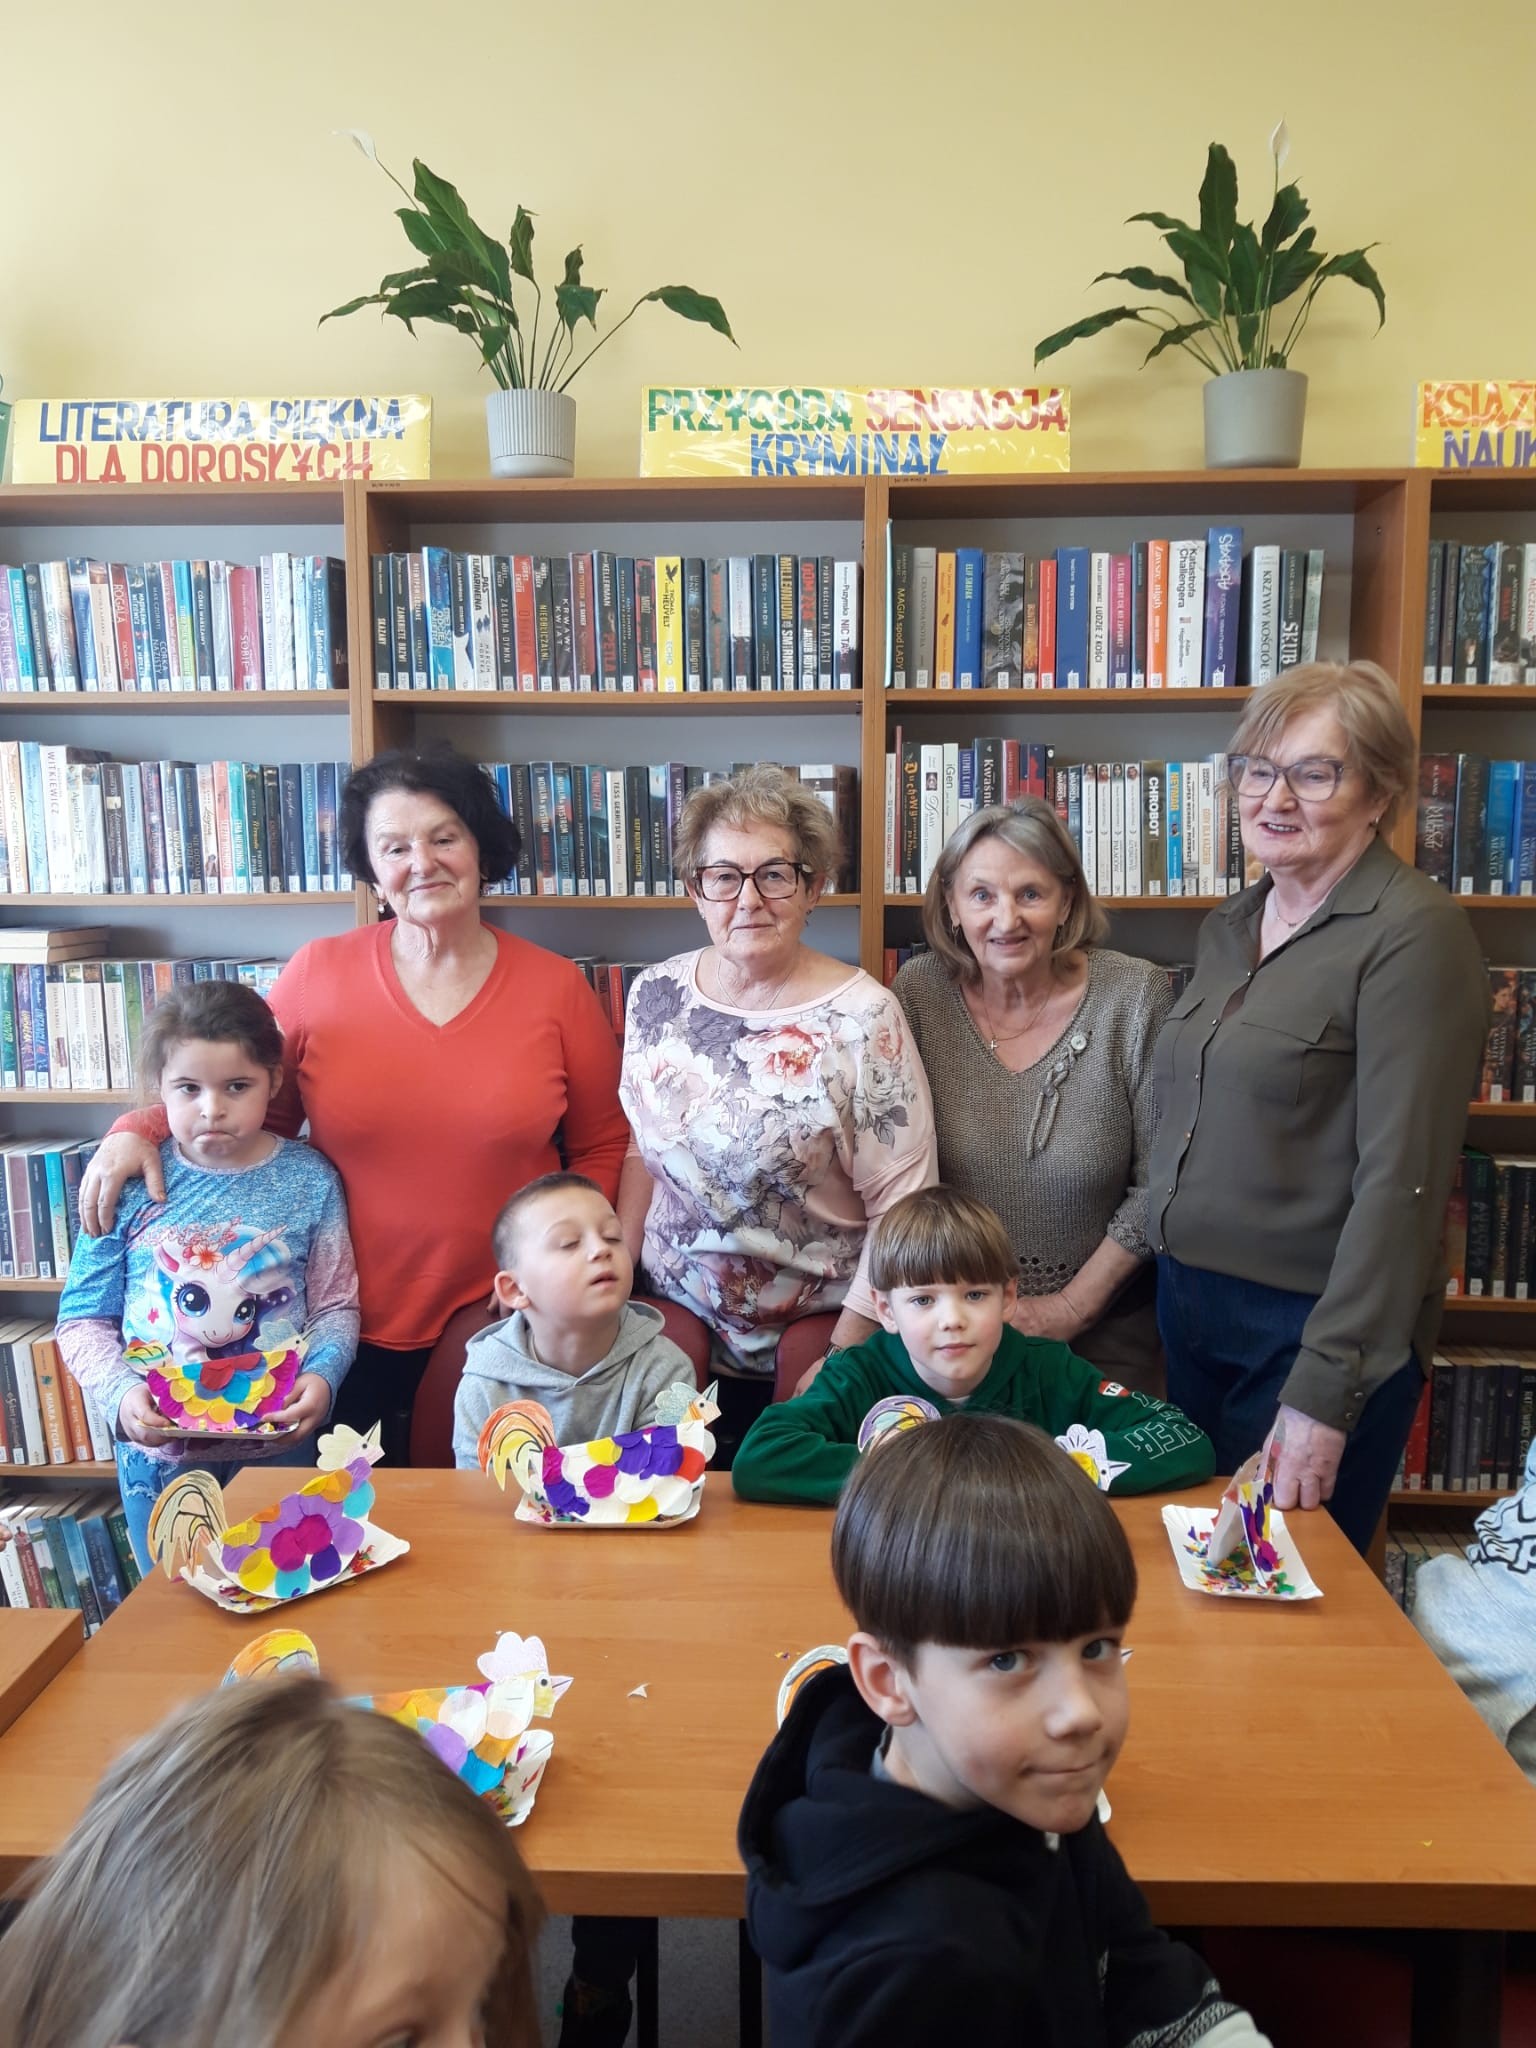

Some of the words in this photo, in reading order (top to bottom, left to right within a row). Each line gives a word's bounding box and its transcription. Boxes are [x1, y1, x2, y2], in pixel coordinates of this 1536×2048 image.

[39, 400, 256, 442] LITERATURA
[269, 398, 405, 447] PIĘKNA
[648, 388, 853, 432] PRZYGODA
[866, 388, 1067, 432] SENSACJA
[56, 443, 126, 484] DLA
[750, 433, 948, 476] KRYMINAŁ
[473, 558, 483, 611] ILMARINENA
[481, 576, 489, 593] PAS
[602, 563, 611, 606] KELLERMAN
[780, 557, 793, 619] MILLENNIUM
[1177, 548, 1189, 608] Challengera
[1187, 548, 1198, 598] Katastrofa
[662, 594, 670, 628] HEUVELT
[897, 588, 905, 620] MAGIA
[1152, 585, 1163, 610] nigdy
[1262, 570, 1273, 617] KRZYWY
[378, 618, 386, 645] SKAZANY
[500, 598, 509, 633] ZASŁONA
[555, 605, 563, 645] KWIAT
[562, 598, 571, 653] KRWAWY
[840, 619, 849, 635] NIC
[896, 623, 905, 642] spod
[1095, 606, 1104, 631] LUDZIE
[502, 637, 511, 663] DYMNA
[665, 641, 674, 665] ECHO
[896, 645, 905, 670] LADY
[1095, 641, 1105, 663] KOŚCI
[1261, 621, 1273, 669] KOŚCIÓŁ
[47, 751, 59, 815] WITKIEWICZ
[946, 764, 955, 789] iGen
[1056, 771, 1064, 801] WARREN
[1069, 772, 1077, 801] WARREN
[1170, 773, 1180, 811] NEYMAR
[614, 801, 622, 839] GERRITSEN
[1149, 776, 1159, 836] CHROBOT
[1231, 827, 1240, 855] KOBALT
[1424, 806, 1436, 848] KAIGENU
[1433, 806, 1445, 848] MIECZ
[1489, 835, 1500, 875] MIASTO
[1520, 836, 1530, 877] MIASTO
[68, 1185, 80, 1212] UGLY
